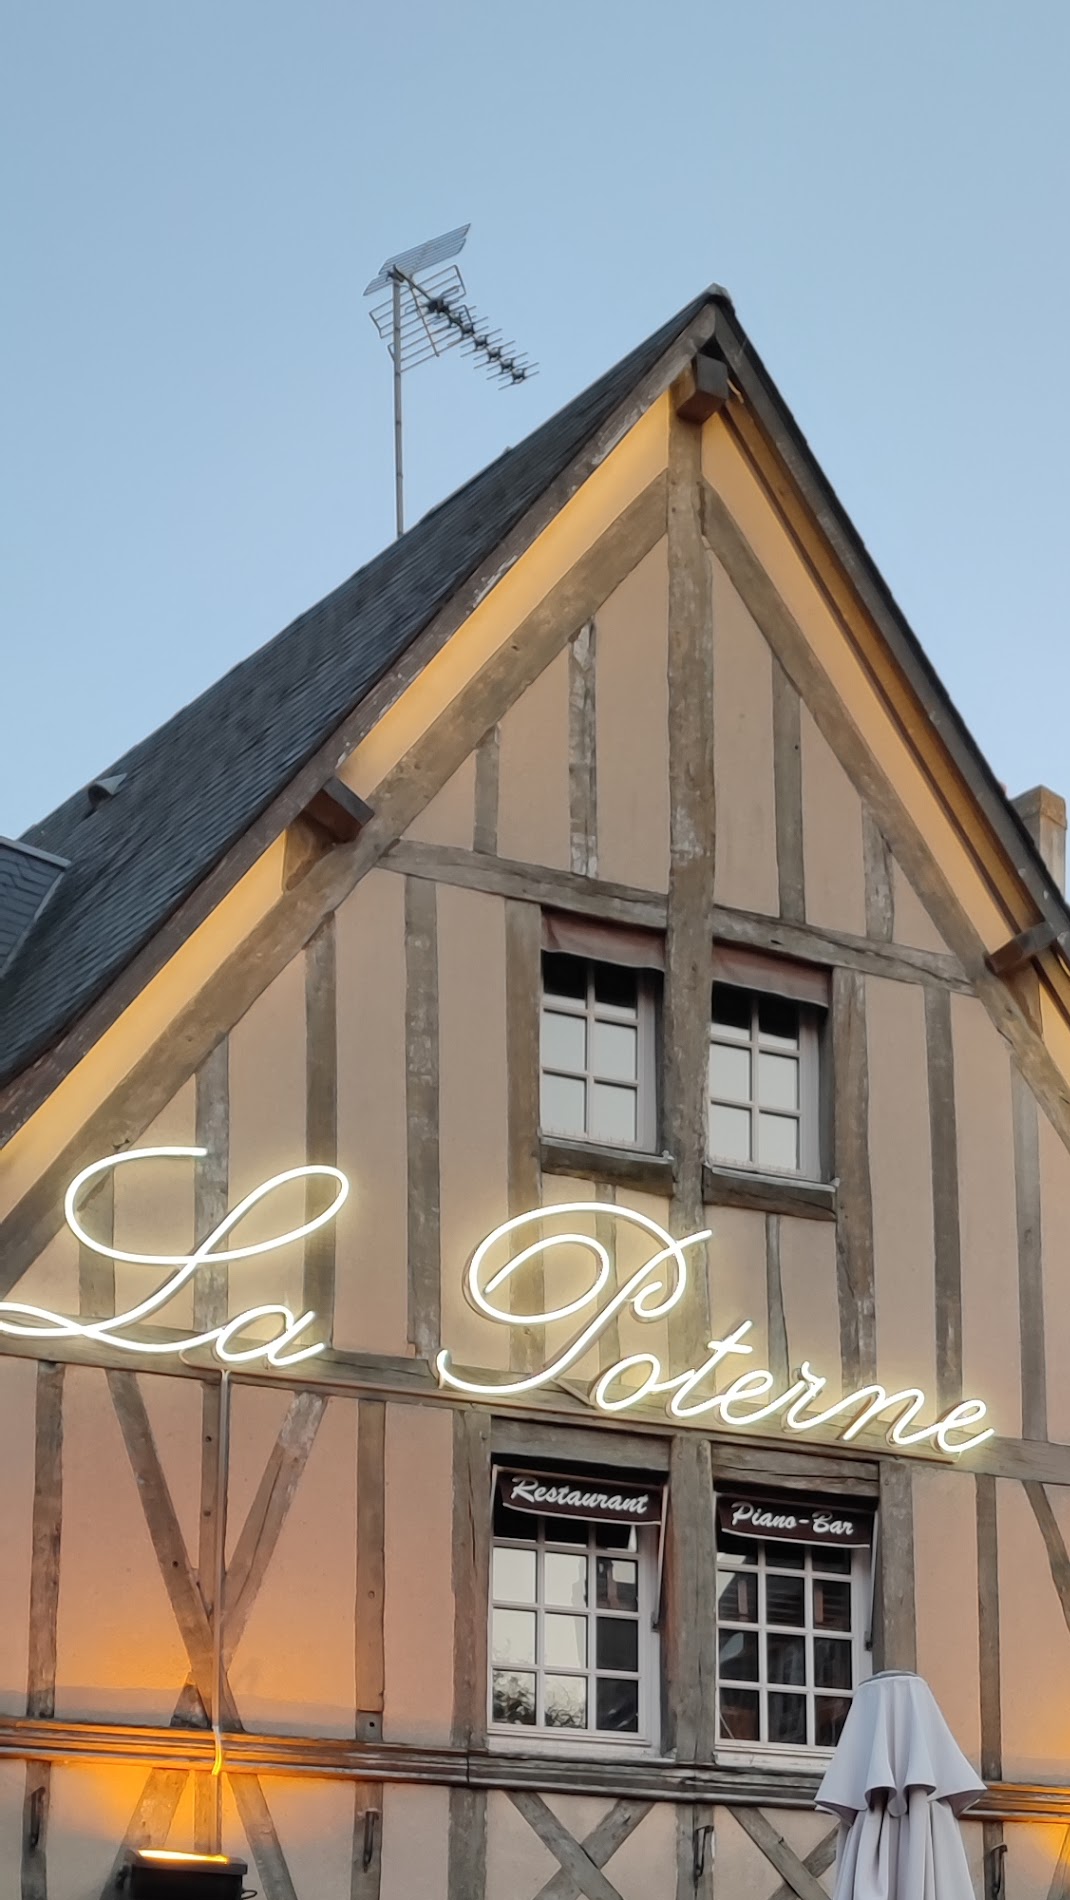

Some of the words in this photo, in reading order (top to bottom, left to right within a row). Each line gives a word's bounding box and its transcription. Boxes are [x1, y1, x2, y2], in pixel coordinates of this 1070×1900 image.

[0, 1145, 350, 1367] La
[436, 1201, 996, 1454] Poterne
[510, 1476, 649, 1515] Restaurant
[730, 1501, 855, 1536] Piano-Bar
